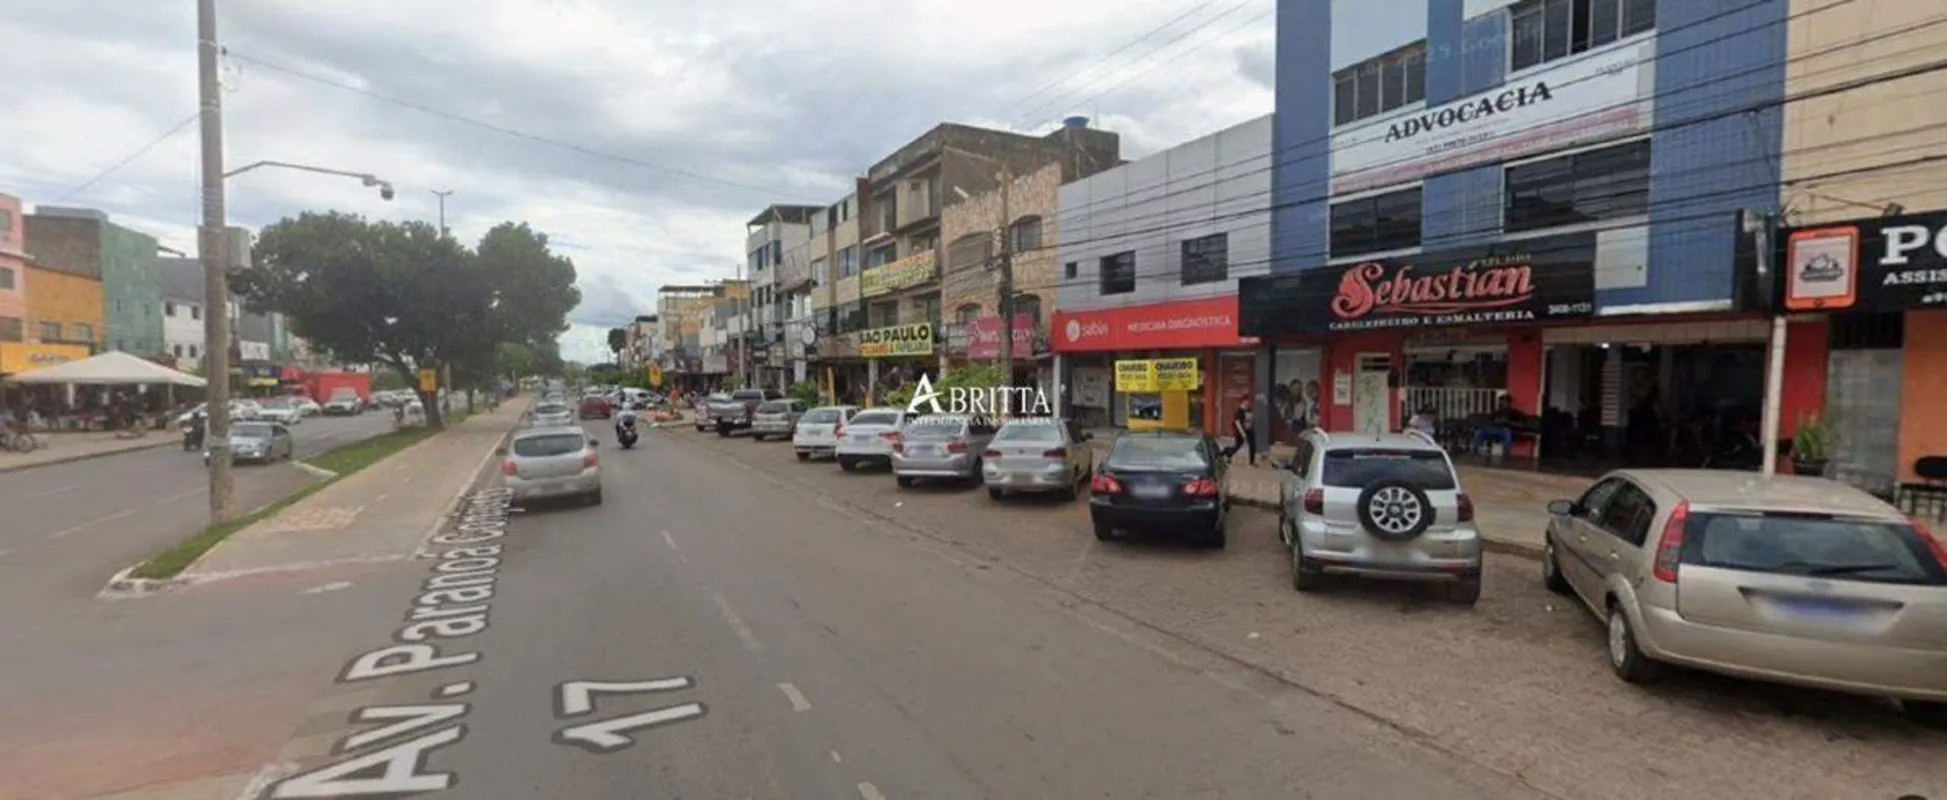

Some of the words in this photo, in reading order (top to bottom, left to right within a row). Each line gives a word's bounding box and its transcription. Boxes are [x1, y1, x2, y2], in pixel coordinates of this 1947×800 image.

[1385, 81, 1553, 143] ADVOCACIA
[1436, 310, 1535, 325] ESMALTERIA
[883, 325, 930, 342] PAULO
[1127, 320, 1166, 333] MEDICINA
